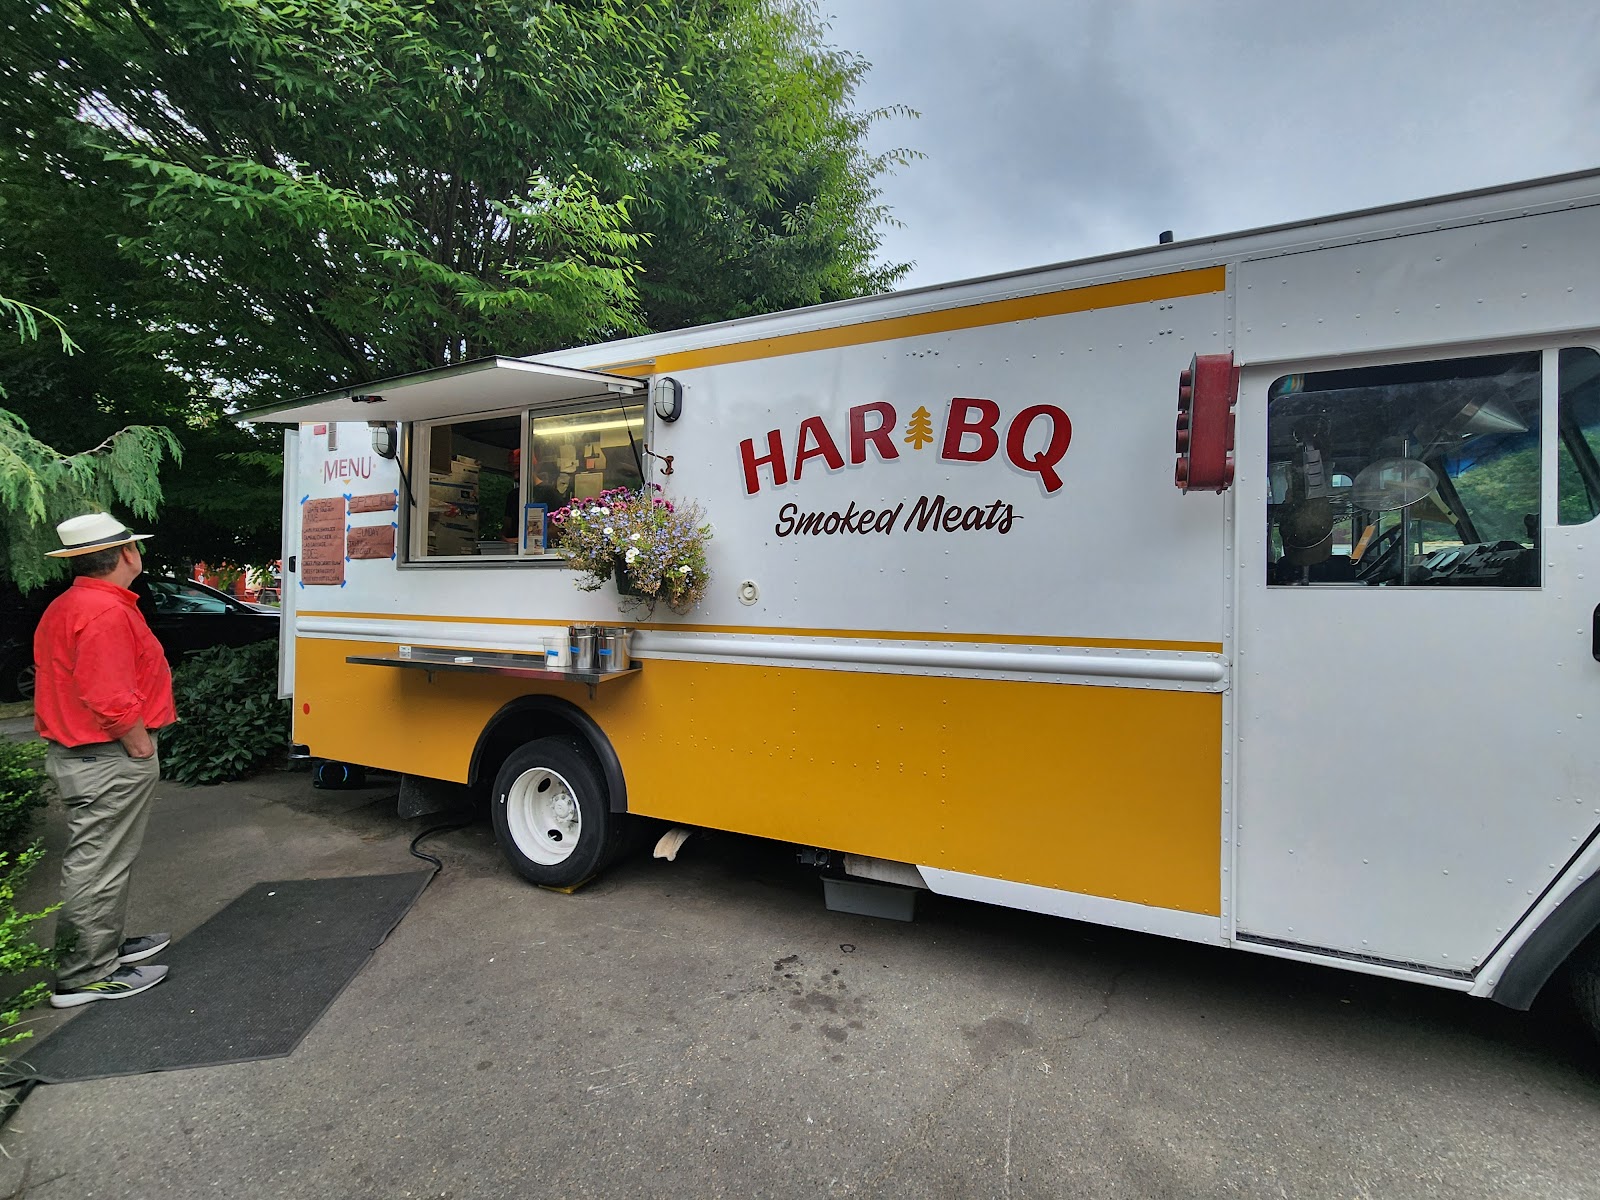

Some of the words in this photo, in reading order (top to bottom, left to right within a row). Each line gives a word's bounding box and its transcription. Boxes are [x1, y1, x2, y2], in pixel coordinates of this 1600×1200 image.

[738, 401, 900, 495] HAR
[940, 397, 1073, 494] BQ
[324, 456, 372, 484] MENU
[775, 500, 903, 537] Smoked
[903, 494, 1023, 535] Meats
